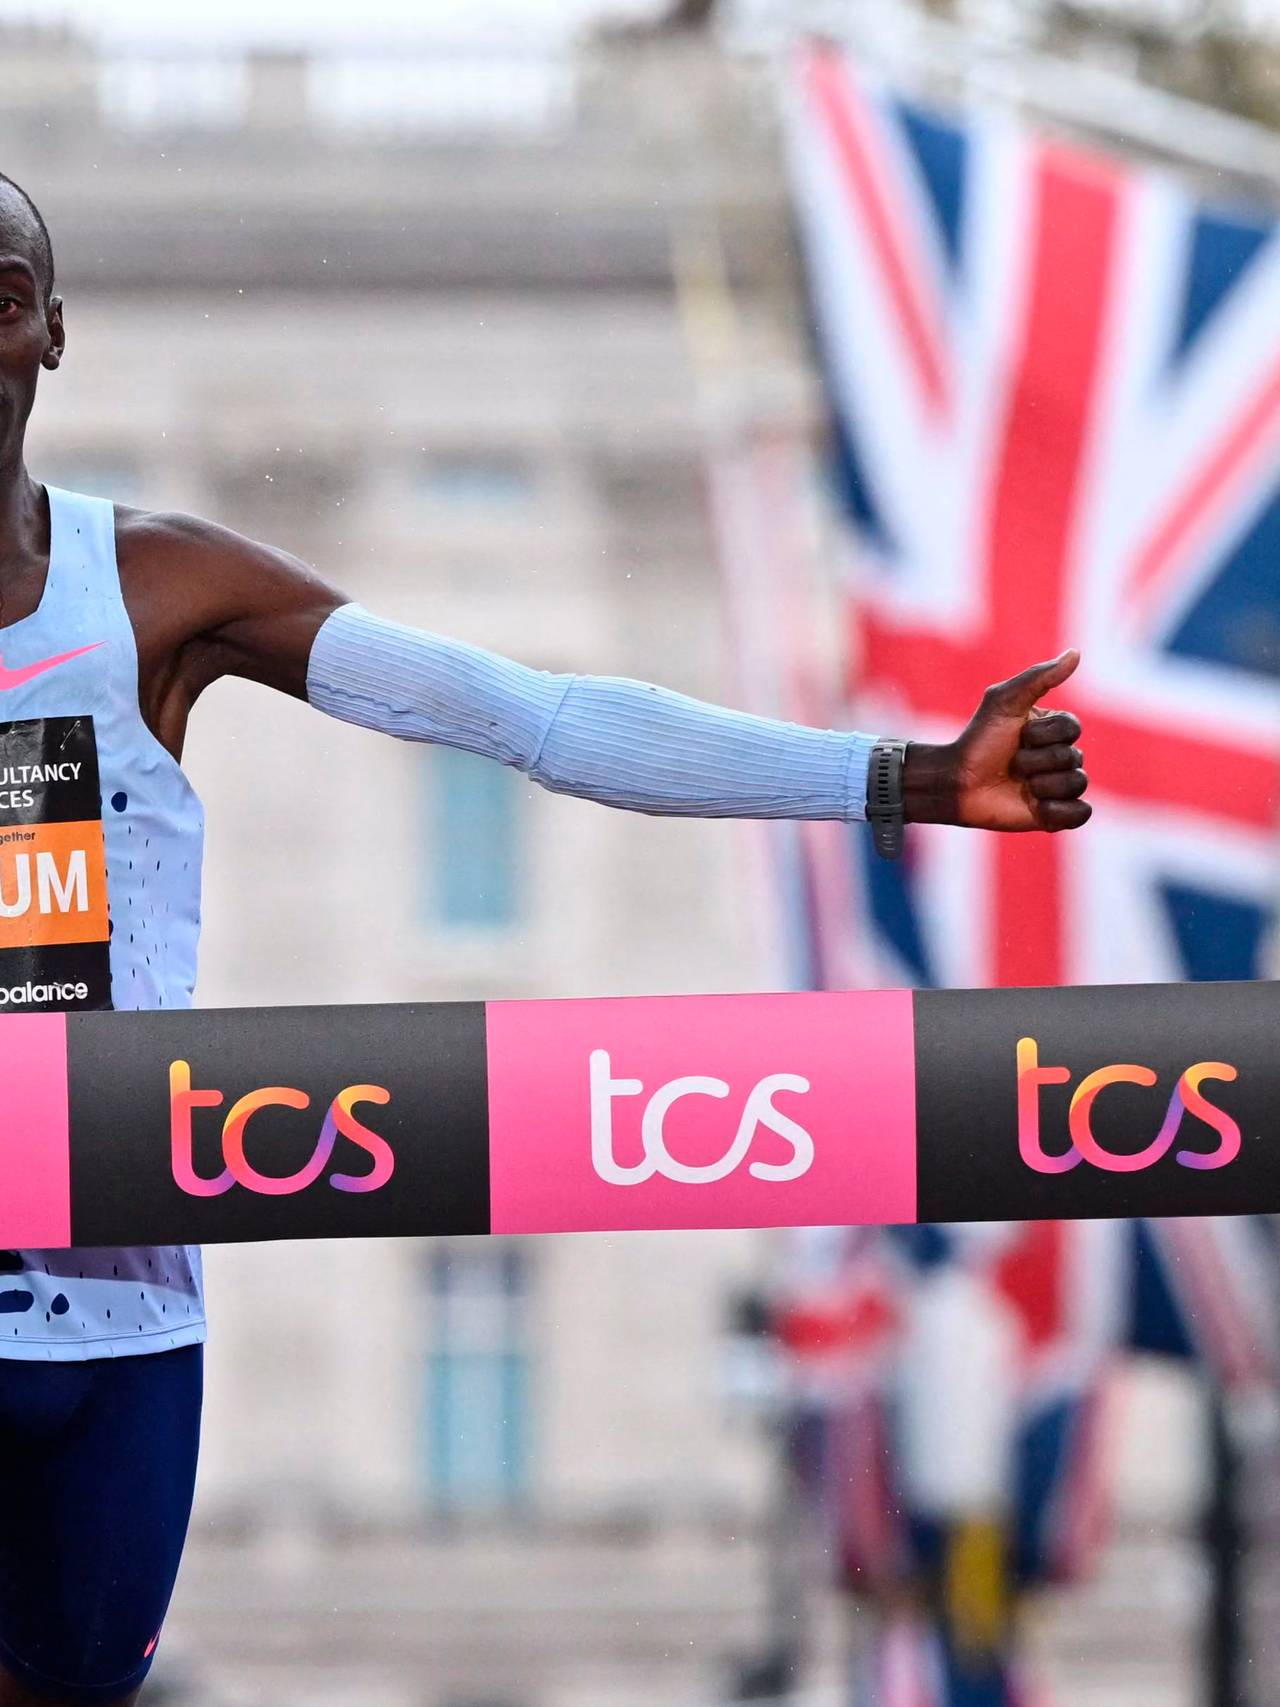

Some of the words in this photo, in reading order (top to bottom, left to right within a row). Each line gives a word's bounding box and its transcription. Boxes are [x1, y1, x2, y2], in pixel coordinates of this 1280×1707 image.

[169, 1060, 396, 1197] tcs
[588, 1048, 815, 1186] tcs
[1016, 1037, 1242, 1174] tcs
